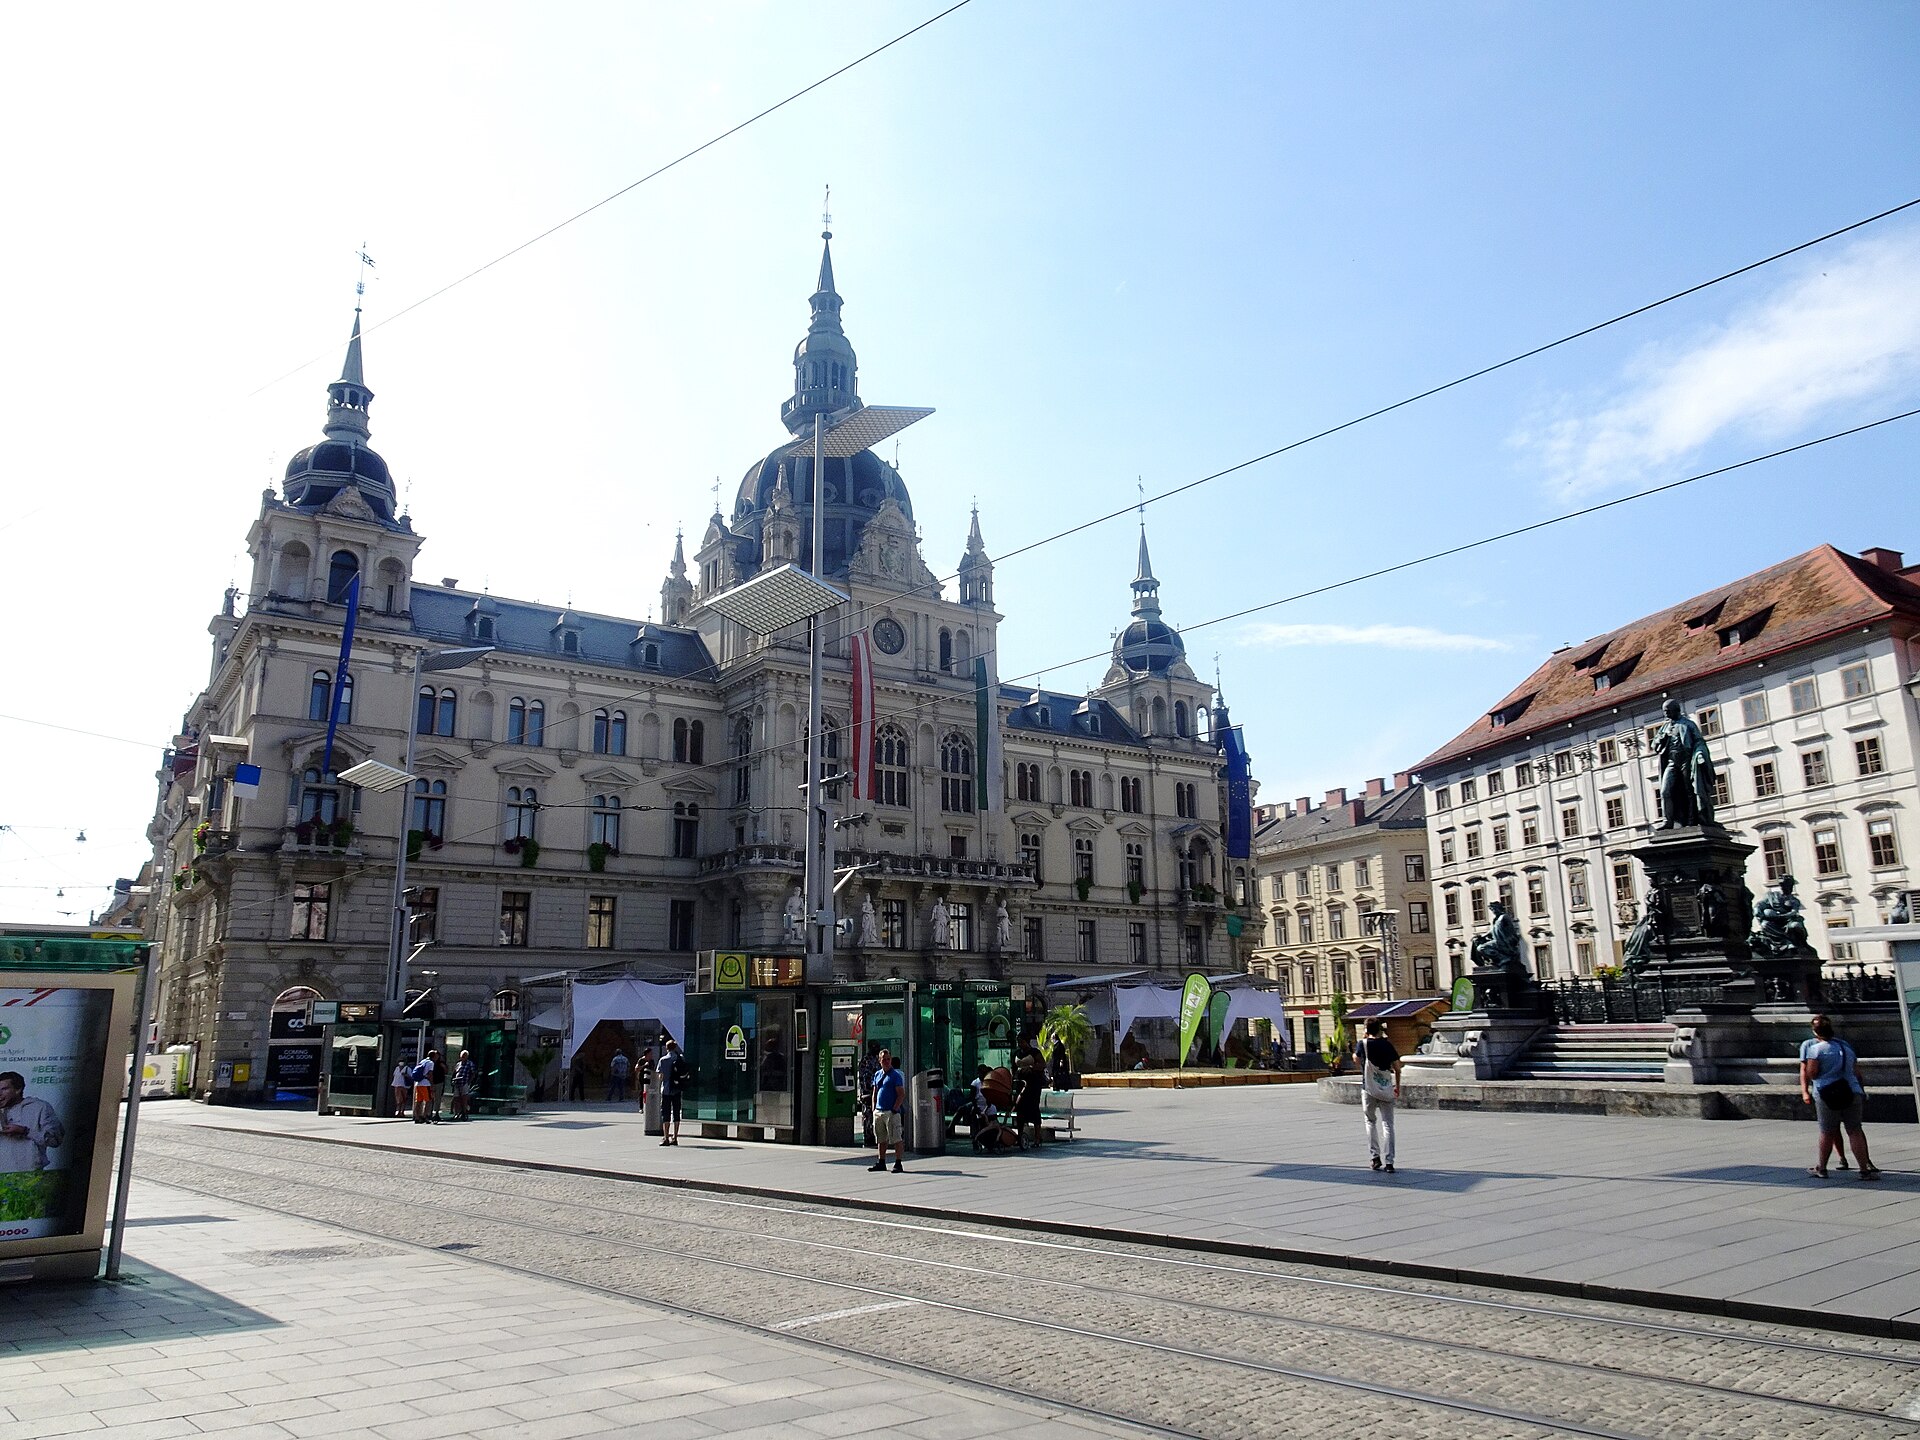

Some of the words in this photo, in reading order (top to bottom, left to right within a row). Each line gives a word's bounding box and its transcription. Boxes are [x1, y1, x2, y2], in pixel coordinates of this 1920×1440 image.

[884, 984, 904, 992] TICKETS
[929, 983, 953, 991] TICKETS
[975, 984, 998, 992] TICKETS
[1181, 983, 1203, 1032] GRAZ
[817, 1048, 826, 1095] TICKETS
